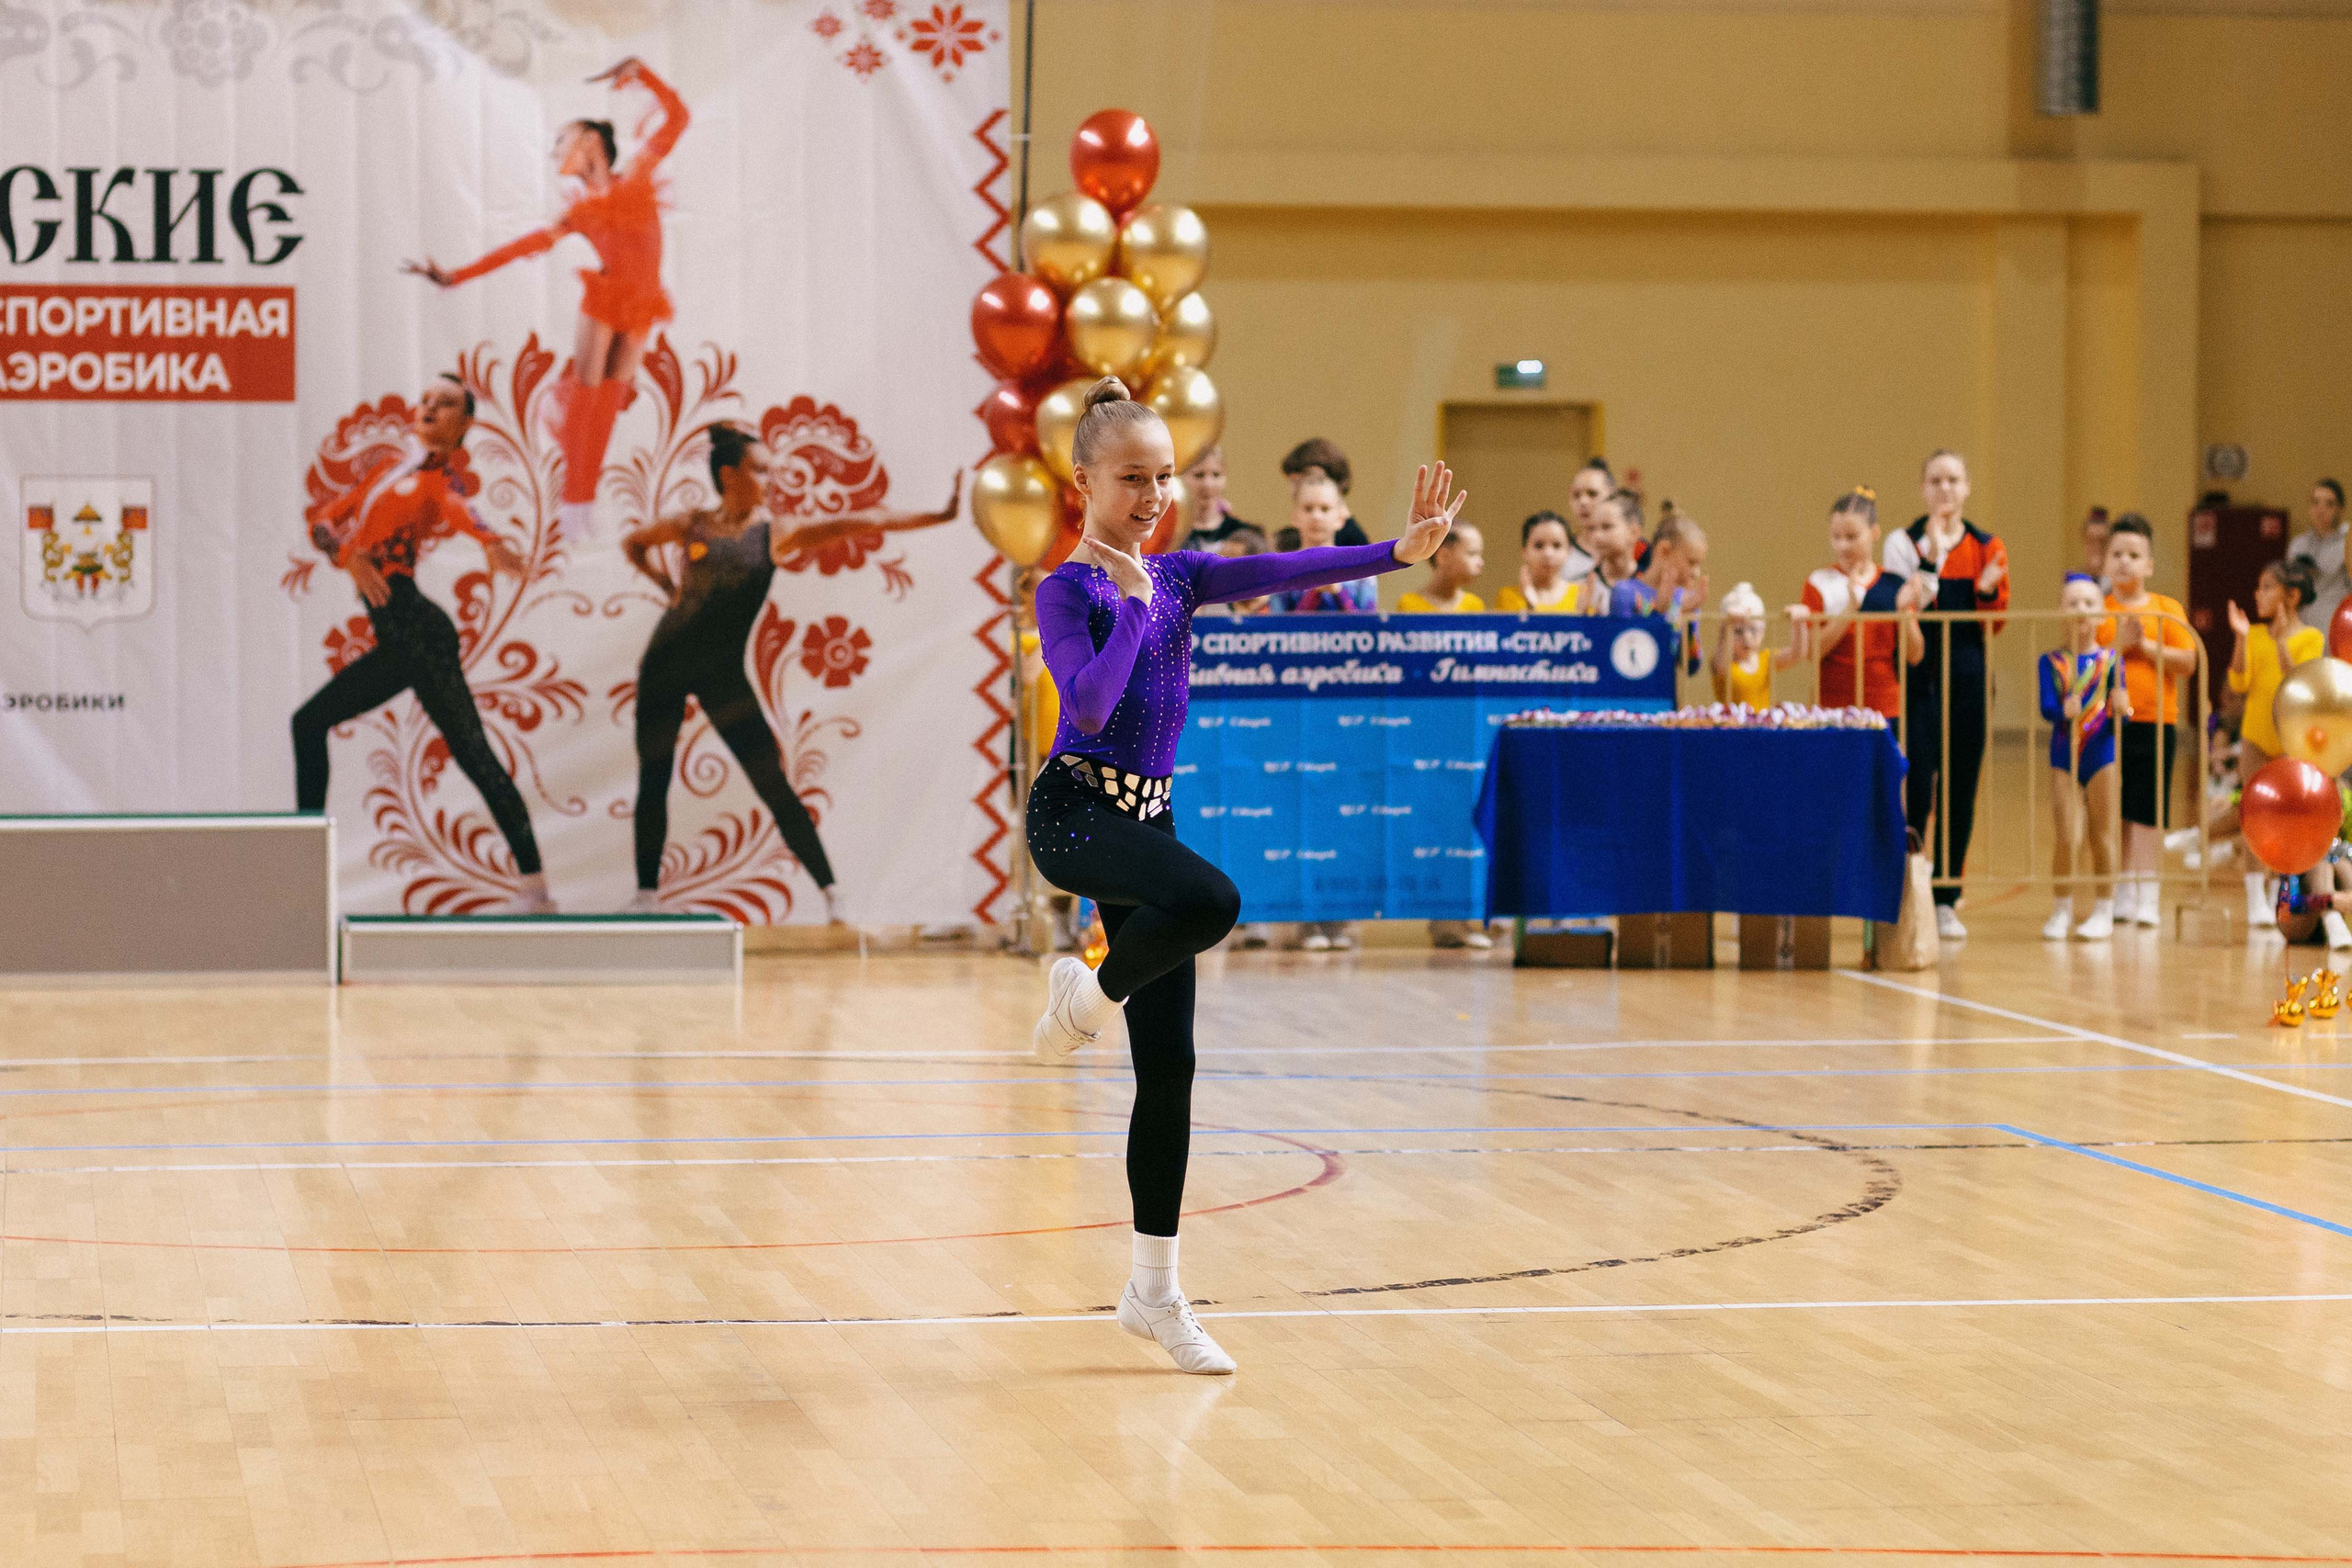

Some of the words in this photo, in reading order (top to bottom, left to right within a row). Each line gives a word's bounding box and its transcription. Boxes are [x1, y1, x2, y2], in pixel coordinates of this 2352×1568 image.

[0, 296, 289, 337] ПОРТИВНАЯ
[0, 351, 231, 393] ЭРОБИКА
[1202, 631, 1374, 655] СПОРТИВНОГО
[1378, 630, 1498, 654] РАЗВИТИЯ
